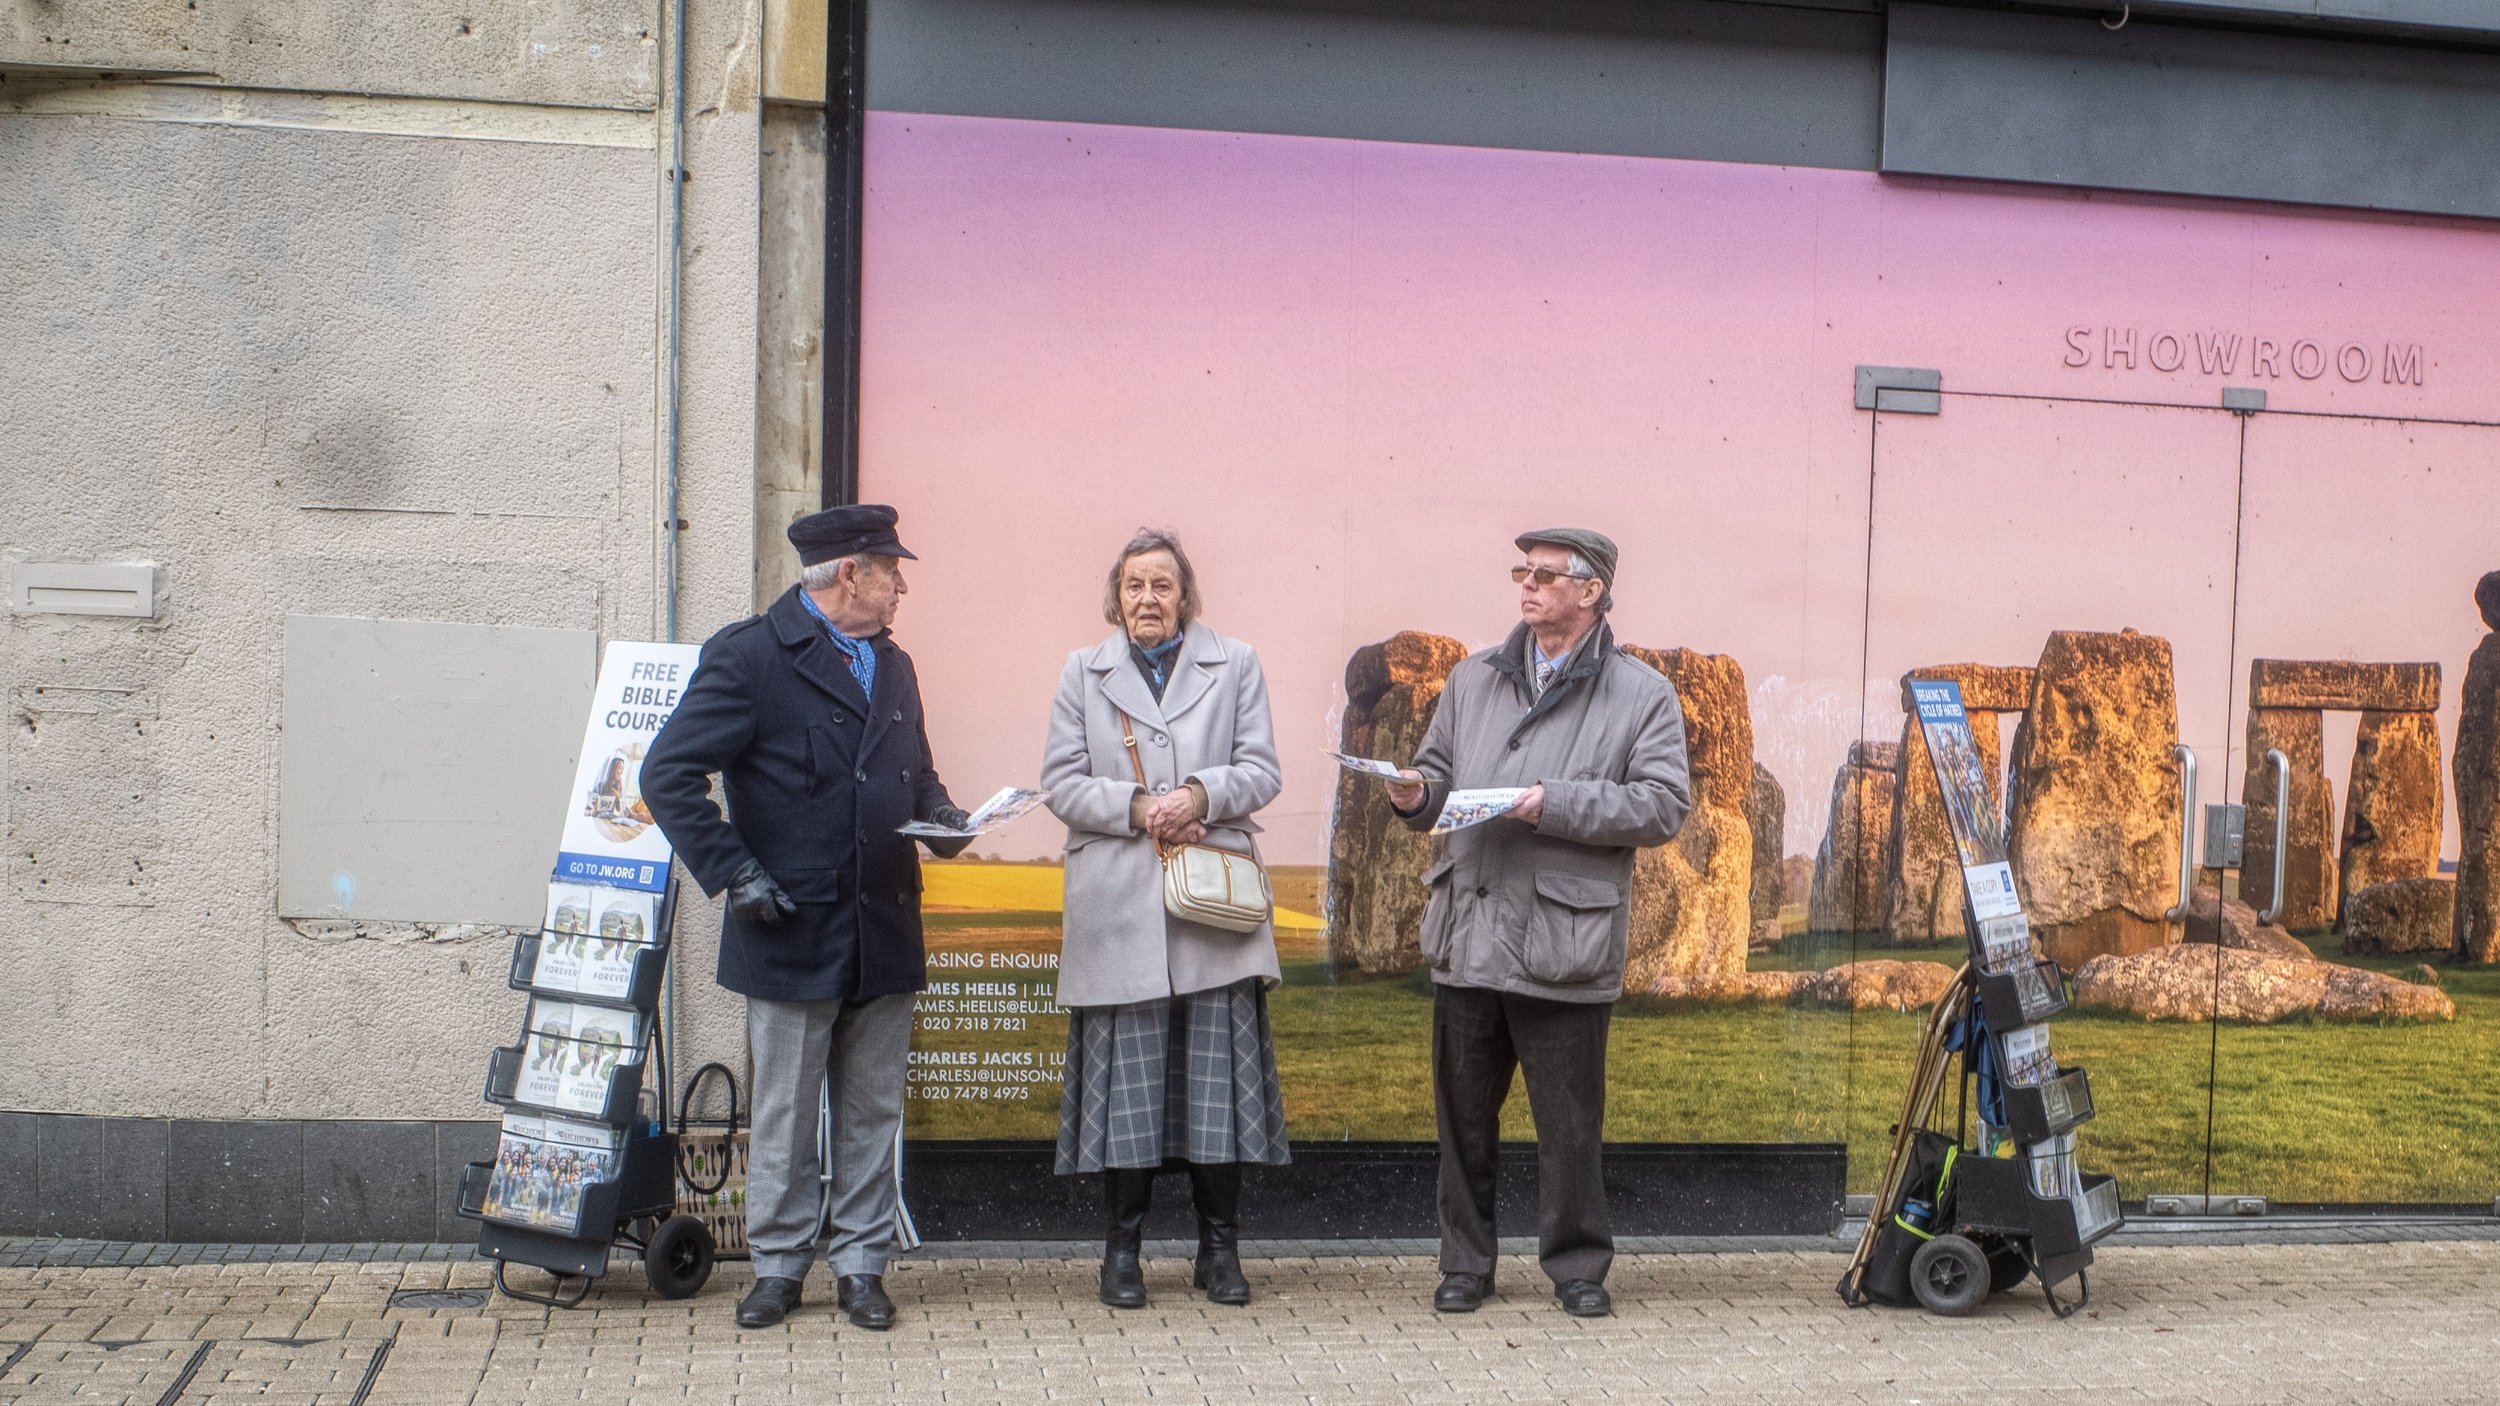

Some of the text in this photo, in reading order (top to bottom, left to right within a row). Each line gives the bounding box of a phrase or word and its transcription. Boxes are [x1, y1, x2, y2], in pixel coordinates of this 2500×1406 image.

[2064, 326, 2423, 386] SHOWROOM
[631, 662, 680, 682] FREE
[622, 686, 678, 707] BIBLE
[606, 710, 671, 732] COURS
[570, 862, 635, 879] GO TO JW.ORG
[926, 952, 1059, 968] ASING ENQUIR
[545, 965, 578, 977] FOREVER
[915, 982, 960, 996] MES
[965, 983, 1017, 996] HEELIS
[1033, 983, 1053, 996] JLL
[912, 1000, 1072, 1014] AMES.HEELIS@EU.JLL.
[923, 1017, 951, 1030] 020
[955, 1017, 988, 1030] 7318
[993, 1018, 1026, 1031] 7821
[907, 1052, 977, 1066] CHARLES
[982, 1052, 1032, 1066] JACKS
[1050, 1052, 1066, 1065] LU
[906, 1069, 1065, 1083] CHARLESJ@LUNSON-M
[529, 1081, 560, 1093] FOREVE
[569, 1087, 604, 1100] FOREVER
[906, 1086, 1029, 1100] T: 020 7478 4975
[512, 1124, 542, 1137] WATCHTOW
[557, 1130, 600, 1145] WATCHTOWER
